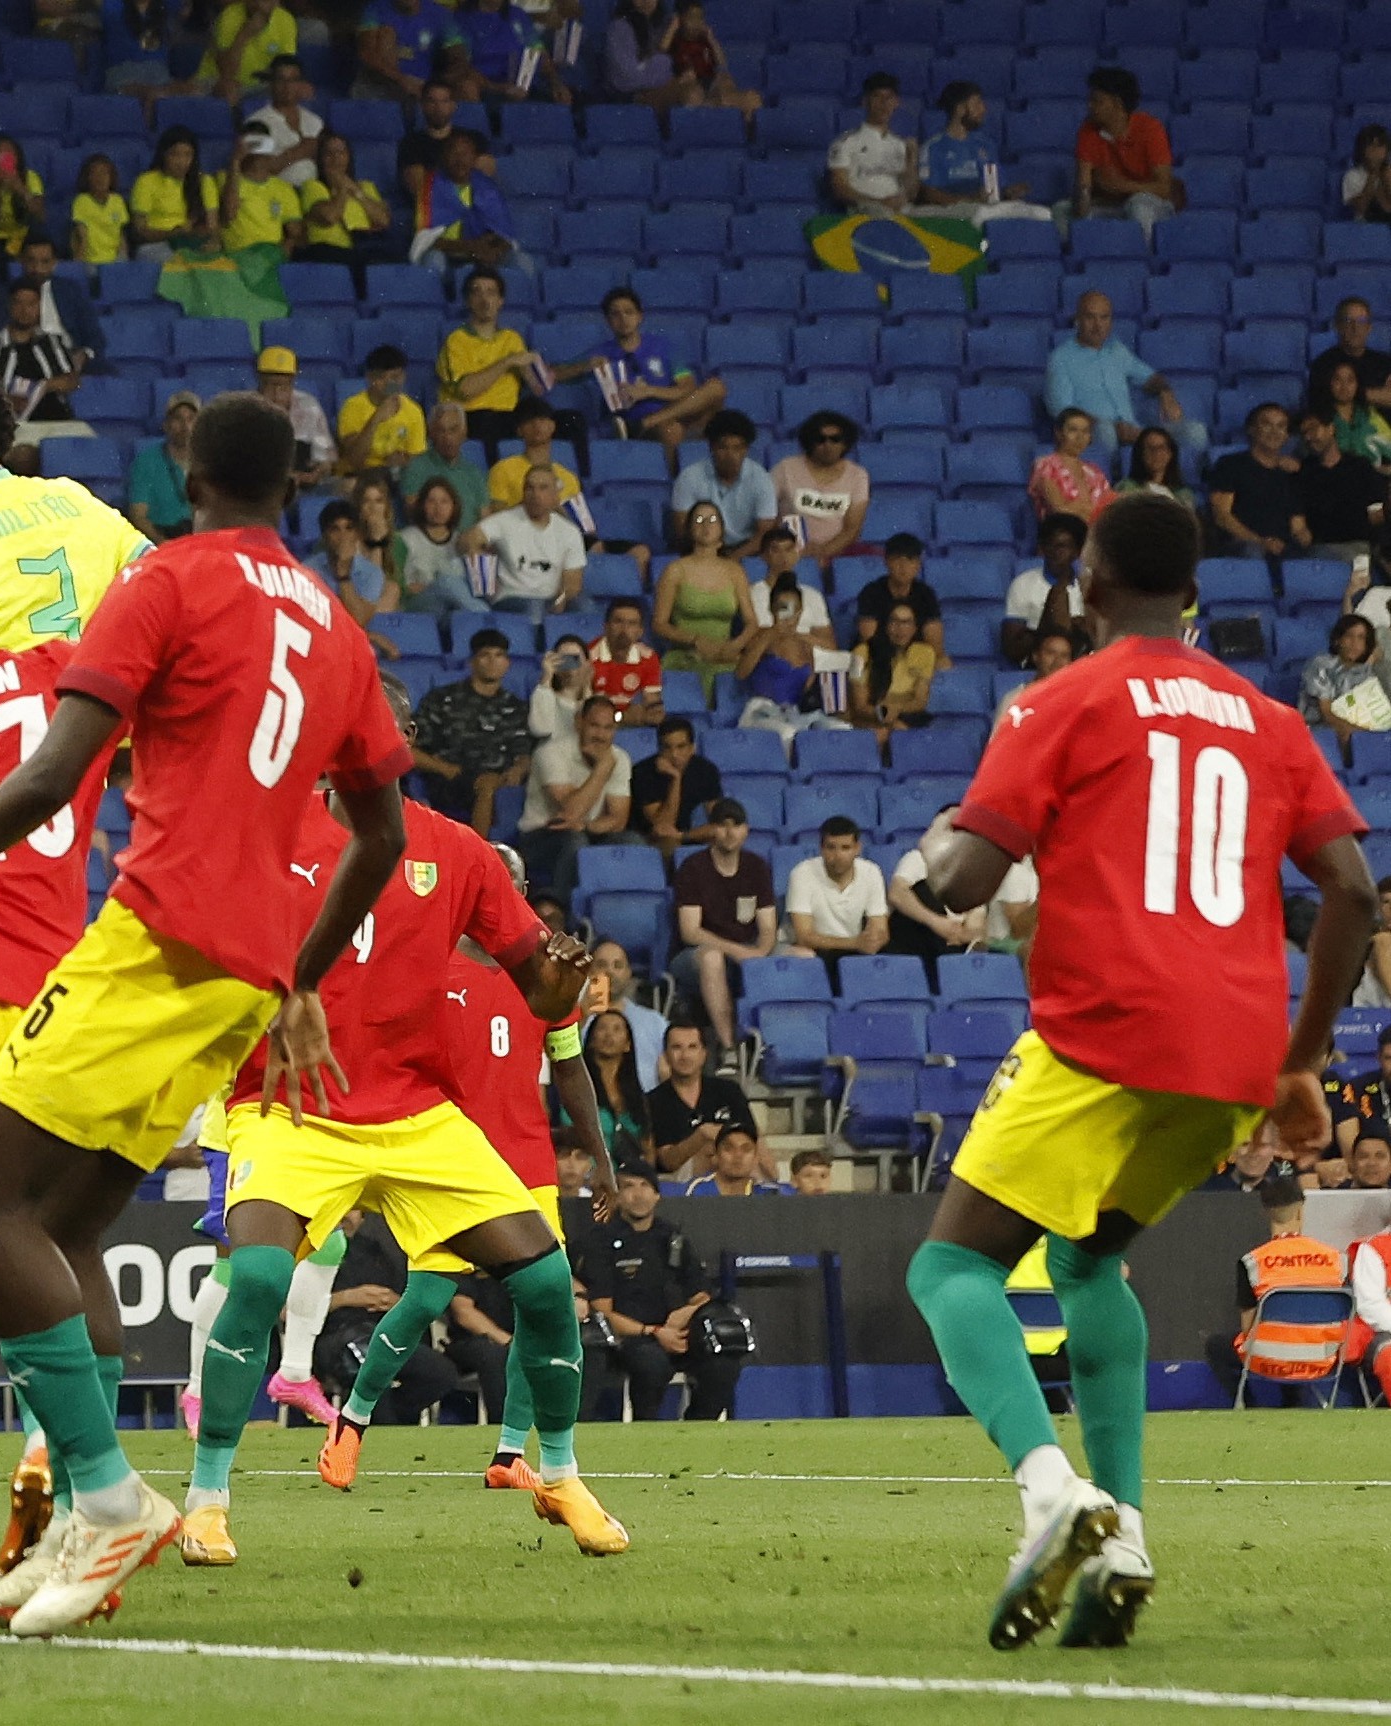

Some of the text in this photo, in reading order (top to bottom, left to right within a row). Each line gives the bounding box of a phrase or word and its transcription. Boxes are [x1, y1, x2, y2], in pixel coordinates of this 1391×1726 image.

[248, 608, 313, 790] 5
[1144, 730, 1250, 928] 10
[23, 982, 69, 1040] 5
[490, 1014, 511, 1058] 8
[1263, 1252, 1334, 1269] CONTROL
